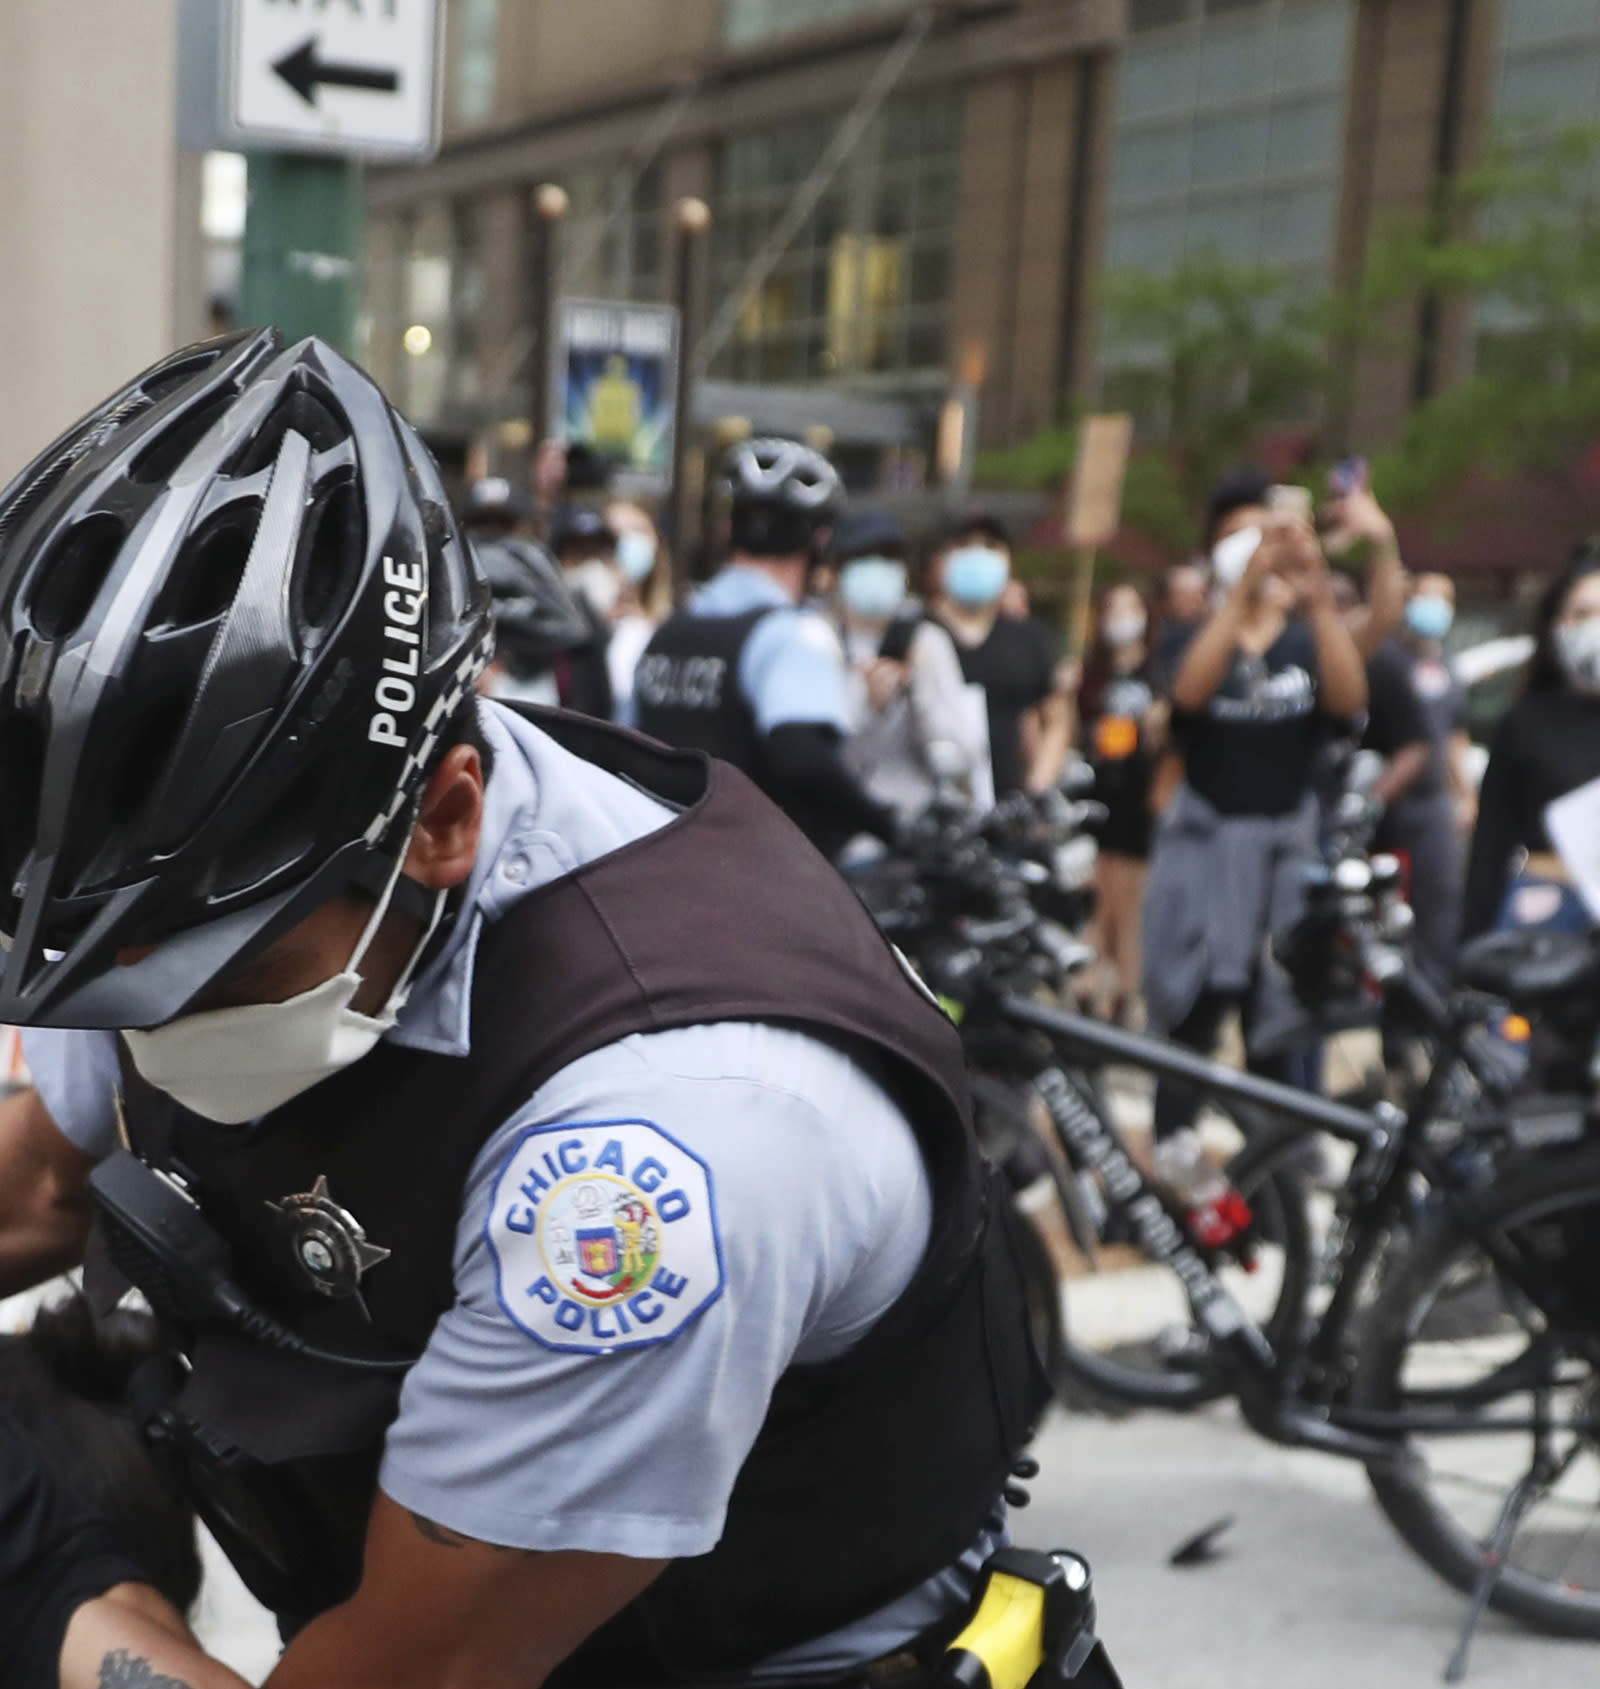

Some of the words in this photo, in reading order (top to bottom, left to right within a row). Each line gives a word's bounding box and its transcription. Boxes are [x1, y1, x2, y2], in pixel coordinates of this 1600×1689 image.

[368, 556, 422, 748] POLICE
[505, 1139, 691, 1235] CHICAGO
[1032, 1066, 1142, 1200] CHICAGO
[1128, 1193, 1216, 1300] POLICE
[526, 1266, 689, 1339] POLICE
